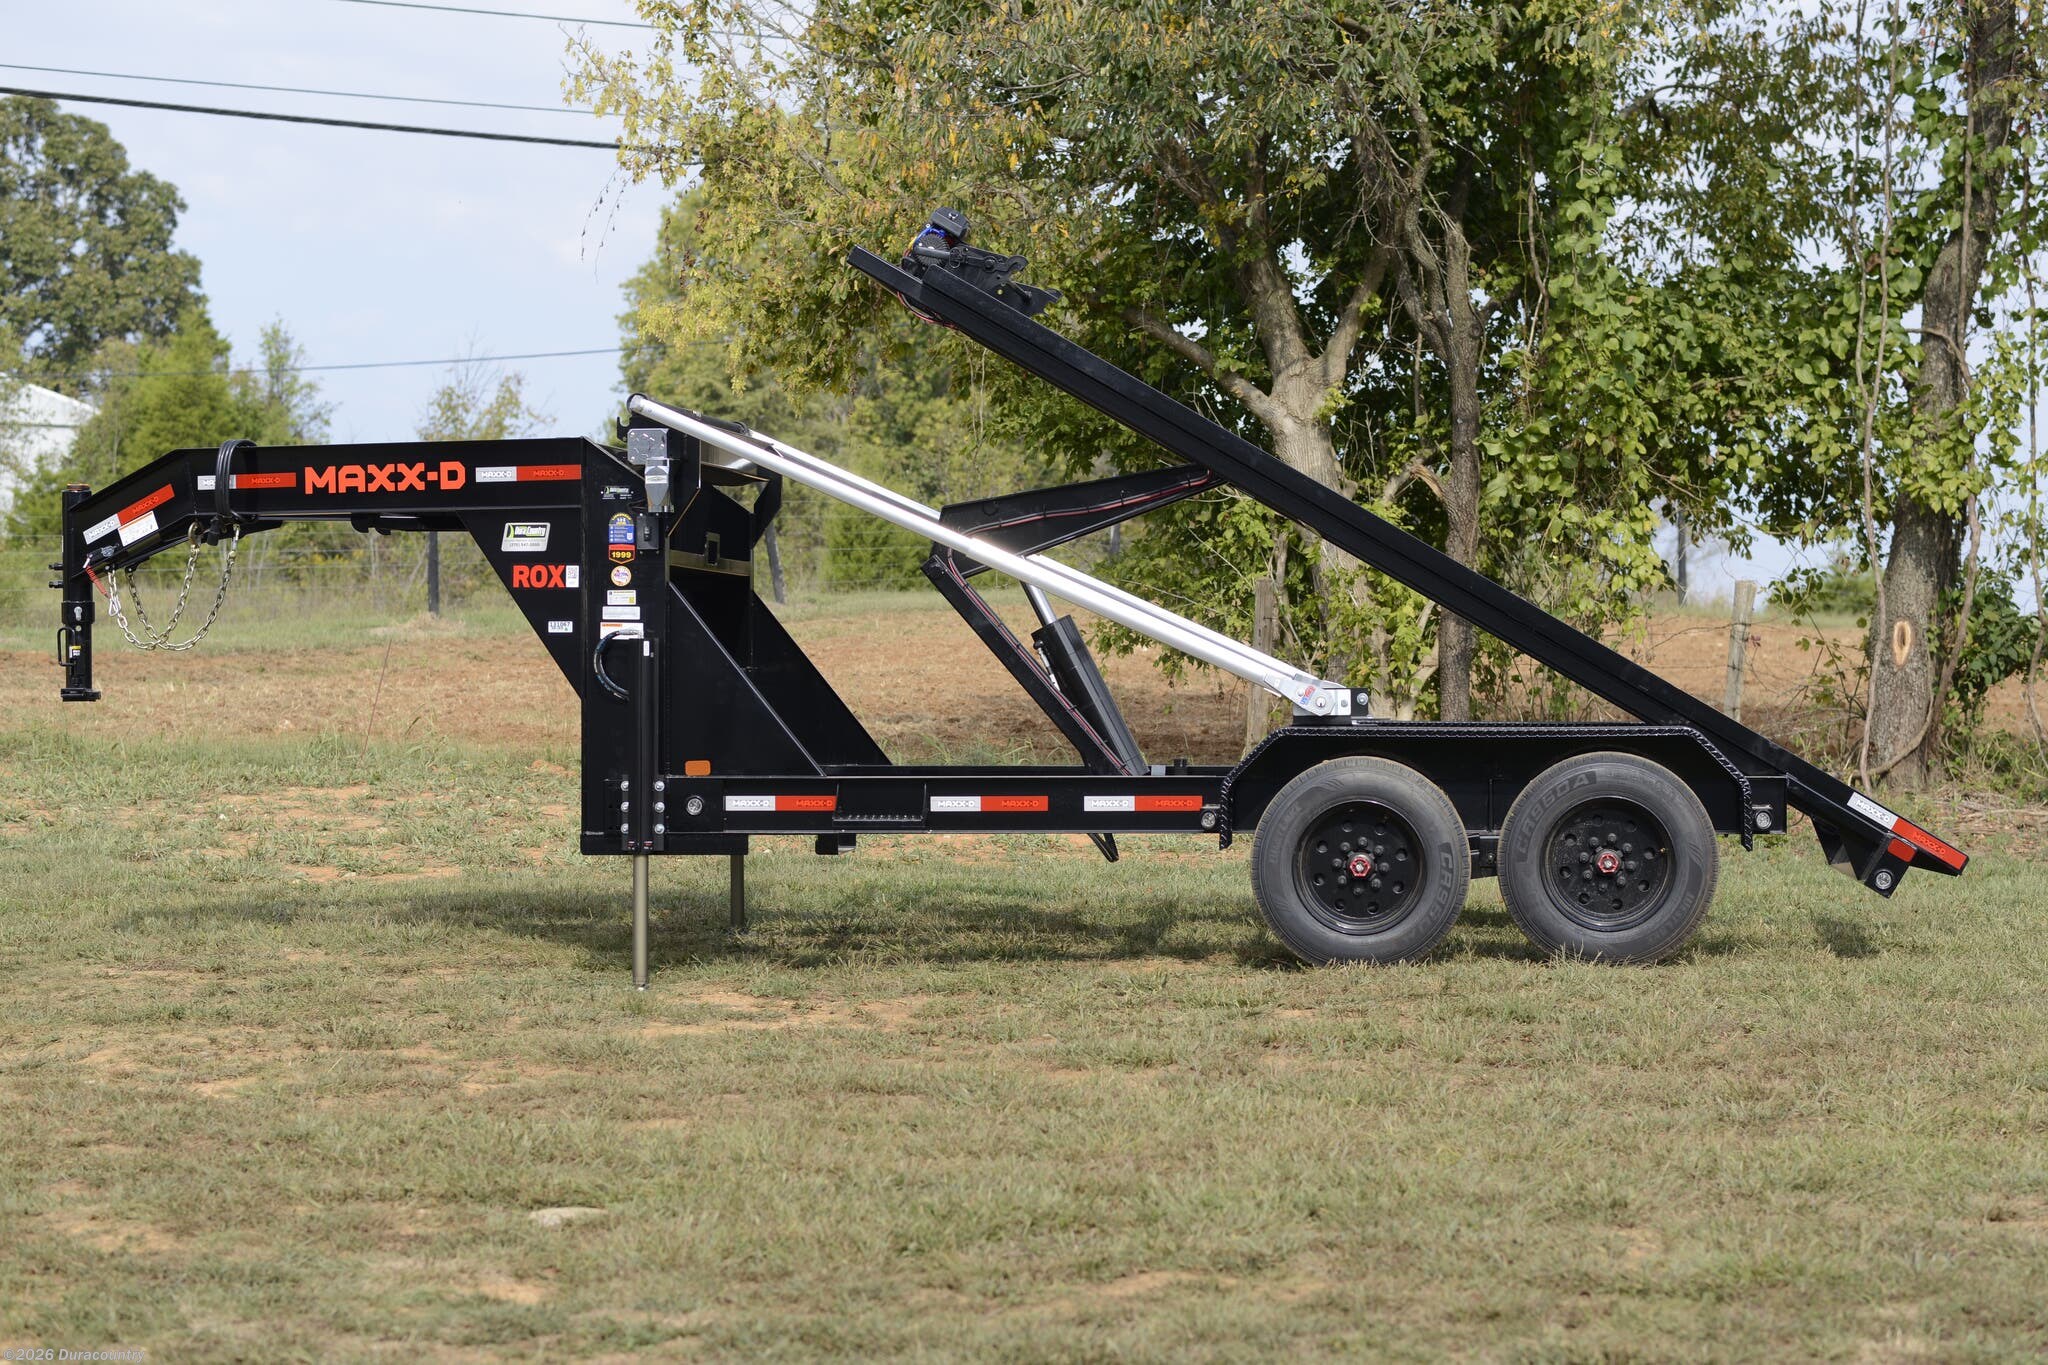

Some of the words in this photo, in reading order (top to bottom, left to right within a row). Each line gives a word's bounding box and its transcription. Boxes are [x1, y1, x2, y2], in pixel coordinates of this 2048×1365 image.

[305, 461, 466, 495] MAXX-D
[481, 471, 512, 479] MAXX-D
[533, 470, 566, 479] MAXX-D
[611, 551, 632, 560] 1999
[513, 565, 566, 588] ROX
[732, 800, 770, 808] MAXX-D
[796, 800, 833, 808] MAXX-D
[937, 800, 976, 808] MAXX-D
[1001, 800, 1039, 808] MAXX-D
[1091, 800, 1129, 808] MAXX-D
[1155, 800, 1193, 808] MAXX-D
[1855, 799, 1890, 823] MAXX-D
[1912, 831, 1946, 856] MAXX-D
